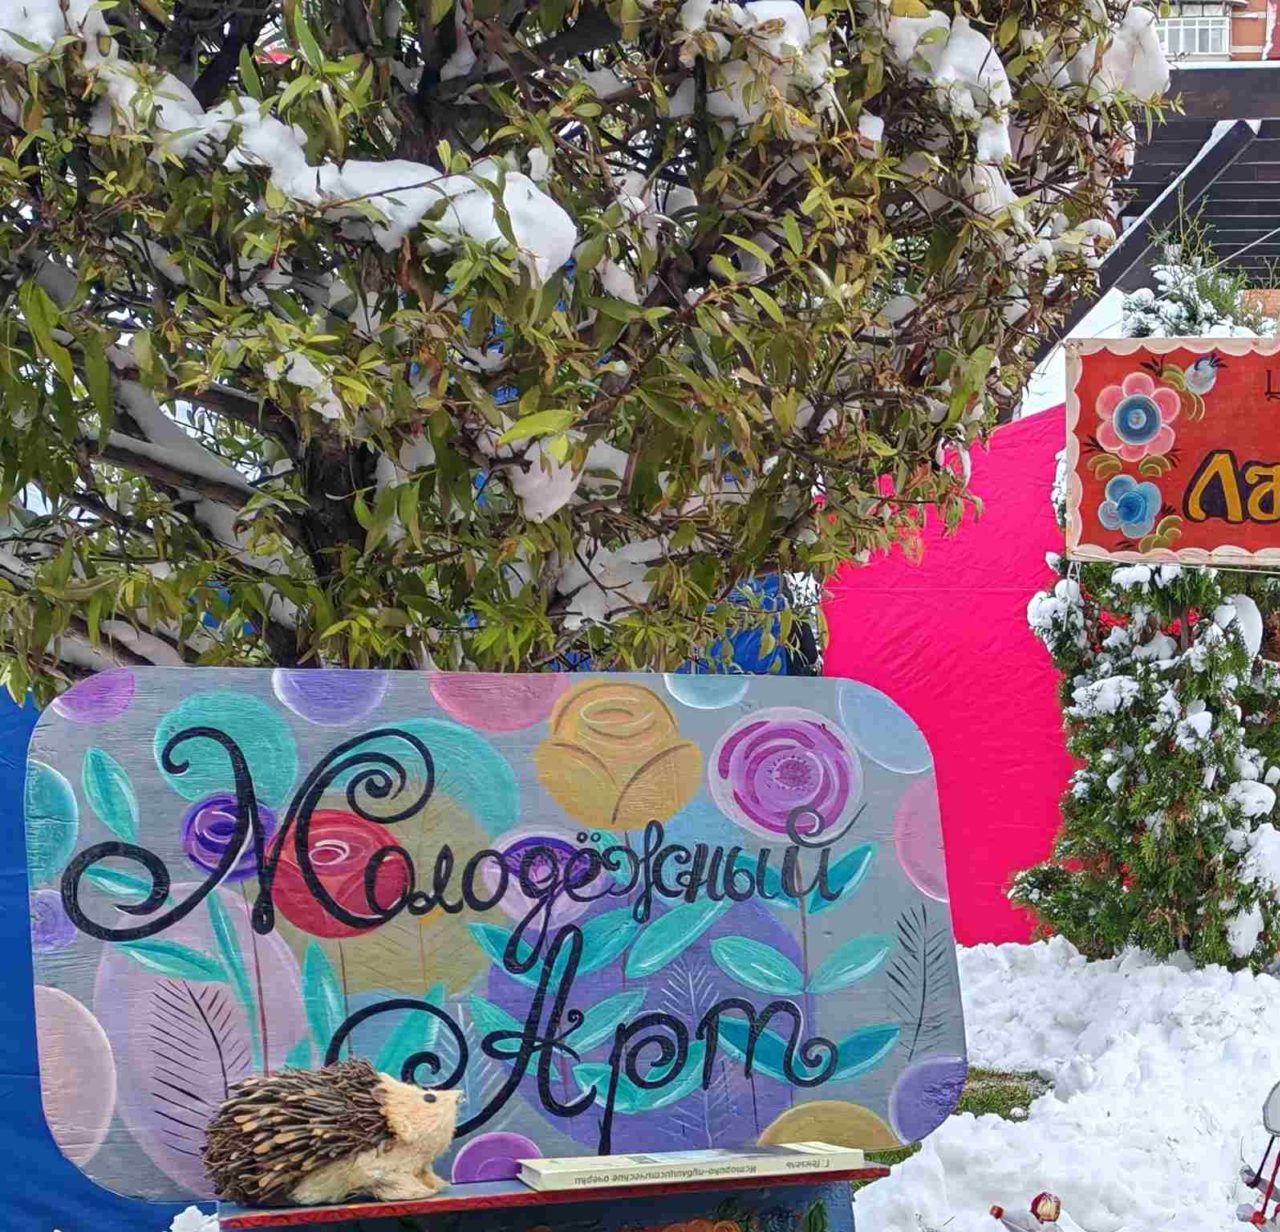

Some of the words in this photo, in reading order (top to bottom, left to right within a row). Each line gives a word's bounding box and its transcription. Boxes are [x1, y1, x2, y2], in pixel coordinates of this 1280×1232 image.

[61, 727, 867, 973] Молодёжный
[325, 924, 838, 1154] Арт
[574, 1174, 609, 1185] очерки
